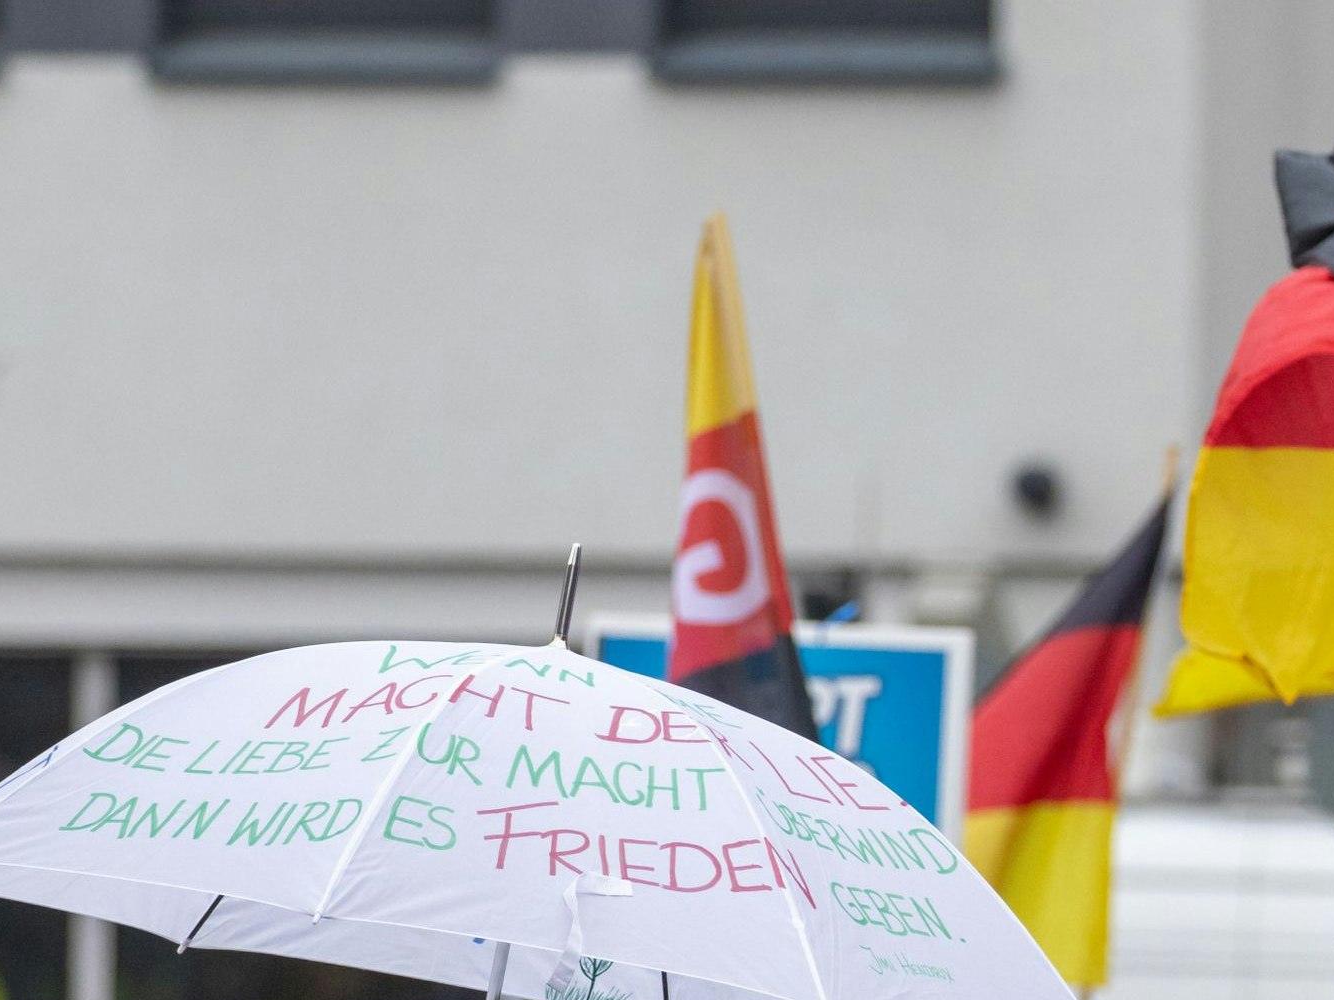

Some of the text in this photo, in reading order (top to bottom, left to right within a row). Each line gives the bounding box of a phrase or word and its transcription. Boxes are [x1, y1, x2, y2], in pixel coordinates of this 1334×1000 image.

[378, 645, 595, 688] WENN
[84, 723, 189, 769] DIE
[184, 737, 349, 775] LIEBE
[361, 722, 483, 786] ZUR
[506, 744, 726, 811] MACHT
[264, 674, 570, 731] MACHT
[595, 705, 755, 771] DER
[58, 792, 967, 943] DANN WIRD ES FRIEDEN GEBEN.
